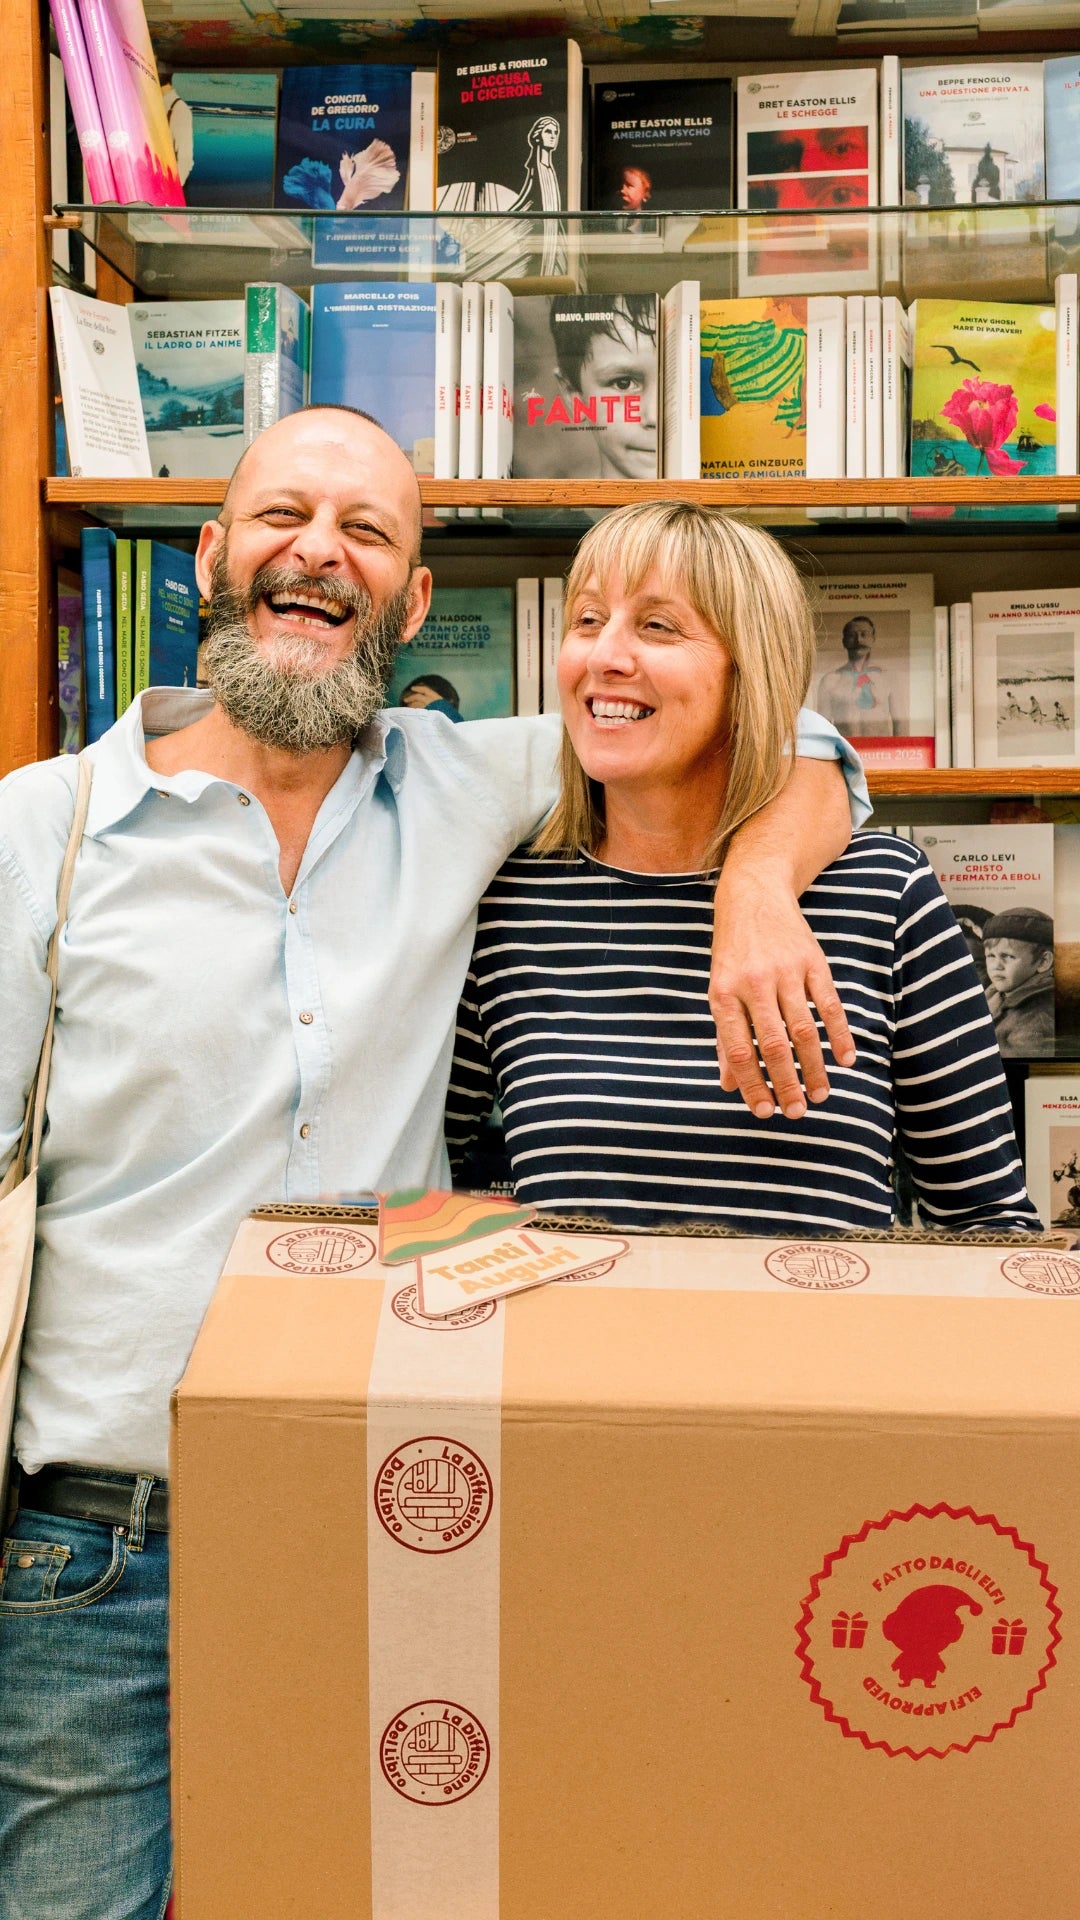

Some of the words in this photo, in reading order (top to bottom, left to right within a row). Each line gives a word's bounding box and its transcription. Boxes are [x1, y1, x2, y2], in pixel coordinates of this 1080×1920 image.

[457, 67, 468, 76] DE
[469, 63, 497, 75] BELLIS
[499, 62, 506, 71] &
[508, 58, 548, 69] FIORILLO
[471, 71, 531, 89] L'ACCUSA
[938, 78, 965, 86] BEPPE
[967, 76, 1011, 84] FENOGLIO
[461, 91, 474, 103] DI
[477, 83, 543, 102] CICERONE
[940, 88, 989, 96] QUESTIONE
[992, 86, 1029, 94] PRIVATA
[324, 94, 367, 104] CONCITA
[759, 100, 784, 109] BRET
[787, 98, 827, 108] EASTON
[829, 96, 856, 105] ELLIS
[311, 106, 324, 115] DE
[326, 104, 379, 114] GREGORIO
[792, 108, 838, 118] SCHEGGE
[312, 119, 330, 131] LA
[334, 117, 375, 130] CURA
[611, 120, 638, 129] BRET
[640, 118, 682, 128] EASTON
[684, 117, 713, 126] ELLIS
[613, 130, 667, 140] AMERICAN
[670, 128, 711, 137] PSYCHO
[324, 304, 375, 313] L'IMMENSA
[555, 313, 583, 322] BRAVO,
[584, 312, 614, 321] BURRO!
[147, 331, 202, 339] SEBASTIAN
[206, 329, 240, 337] FITZEK
[986, 327, 1022, 335] PAPAVERI
[157, 341, 192, 349] LADRO
[527, 395, 642, 426] FANTE
[701, 461, 745, 469] NATALIA
[749, 459, 803, 467] GINZBURG
[703, 471, 739, 479] ESSICO
[744, 470, 807, 478] FAMIGLIARE
[860, 751, 892, 763] gutta
[895, 749, 923, 760] 2025
[953, 854, 988, 862] CARLO
[965, 864, 1003, 873] CRISTO
[940, 873, 946, 882] È
[950, 874, 998, 882] FERMATO
[1010, 873, 1041, 881] EBOLI
[490, 1181, 515, 1189] ALEX
[278, 1237, 296, 1247] La
[296, 1228, 366, 1249] Diffusione
[427, 1242, 529, 1281] Tanti
[772, 1254, 787, 1263] La
[786, 1246, 857, 1265] Diffusione
[283, 1261, 307, 1272] Del
[310, 1263, 353, 1273] Libro
[458, 1246, 581, 1295] Auguri
[787, 1277, 812, 1288] Del
[816, 1279, 854, 1288] Libro
[1026, 1283, 1050, 1293] Del
[396, 1300, 414, 1321] Libro
[441, 1446, 464, 1466] La
[381, 1456, 405, 1486] Del
[442, 1461, 488, 1542] Diffusione
[380, 1488, 403, 1532] Libro
[872, 1557, 926, 1592] FATTO
[930, 1556, 981, 1581] DAGLI
[977, 1574, 1006, 1606] ELFI
[863, 1676, 947, 1716] APPROVED
[949, 1686, 983, 1712] ELFI
[442, 1708, 463, 1726] La
[386, 1719, 408, 1746] Del
[443, 1722, 486, 1794] Diffusione
[385, 1748, 406, 1788] Libro
